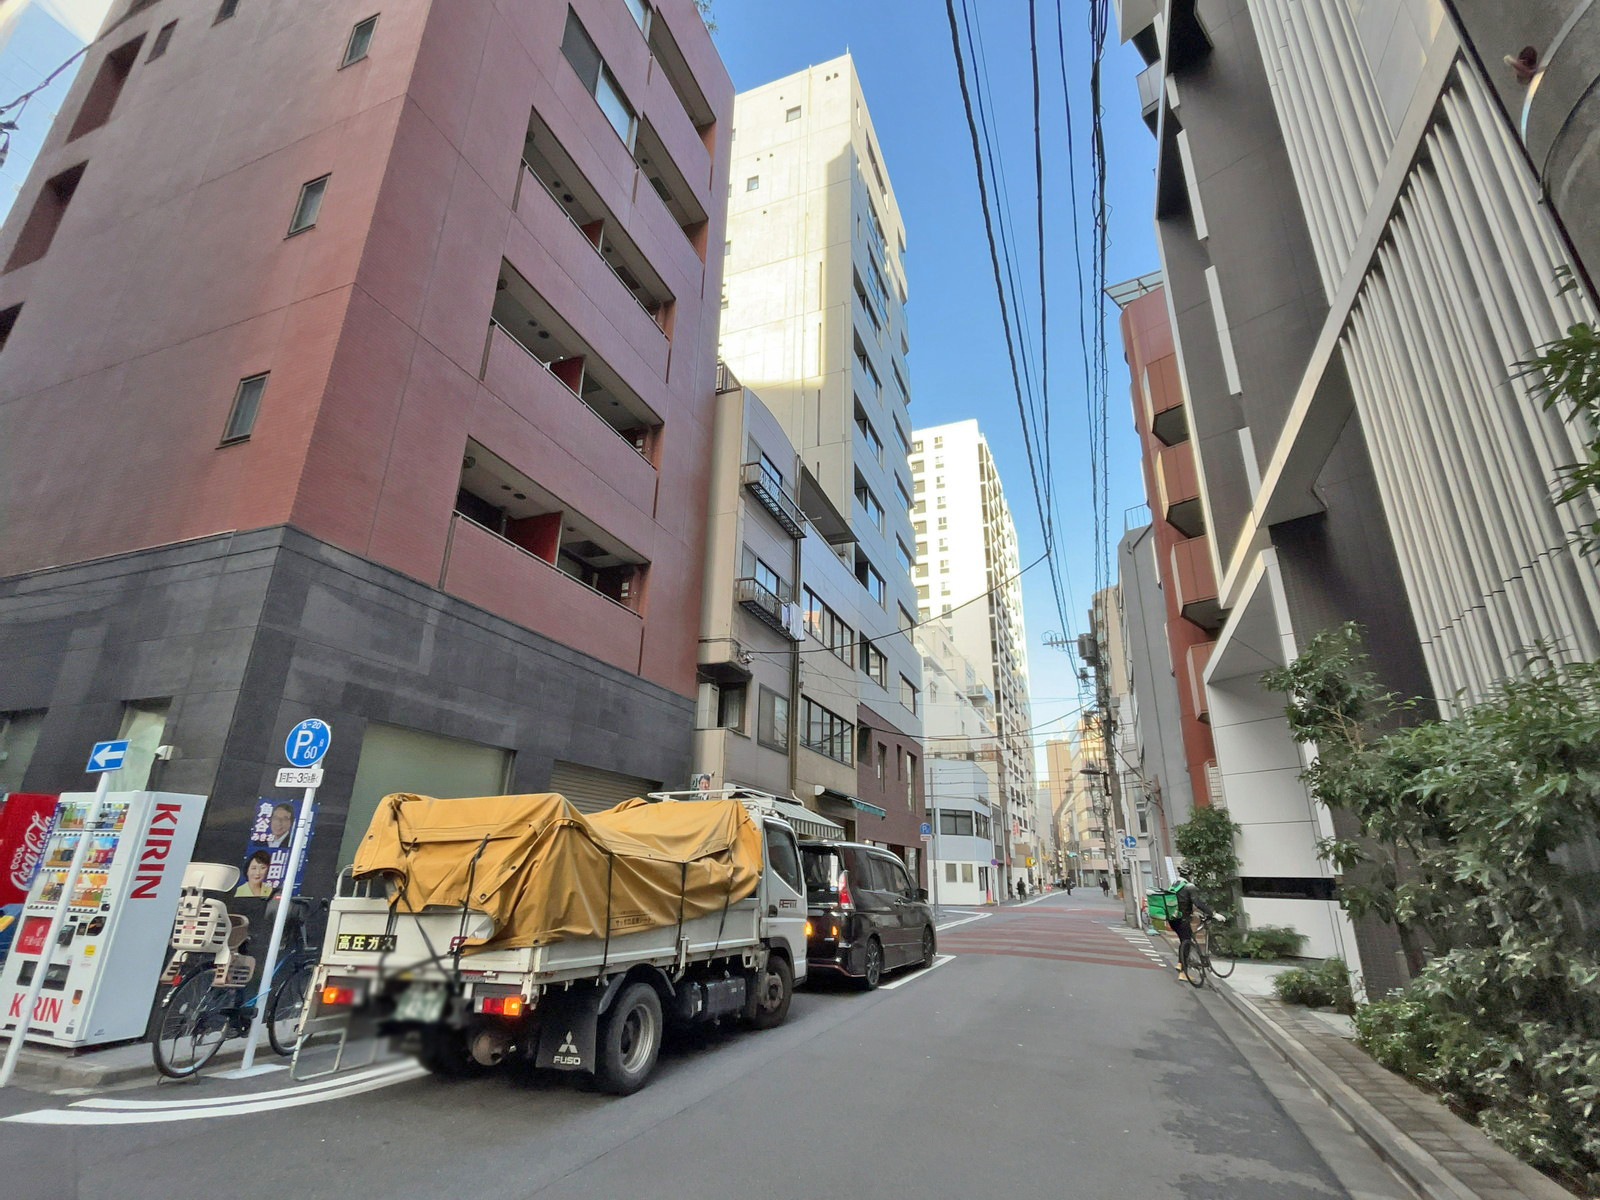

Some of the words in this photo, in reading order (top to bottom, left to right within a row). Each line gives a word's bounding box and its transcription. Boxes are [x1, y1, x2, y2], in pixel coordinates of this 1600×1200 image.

[302, 721, 322, 730] 8-20
[292, 730, 314, 759] P
[130, 803, 182, 899] KIRIN
[338, 935, 394, 950] 高圧ガス
[8, 992, 64, 1024] KRIN
[553, 1055, 581, 1065] FUSO
